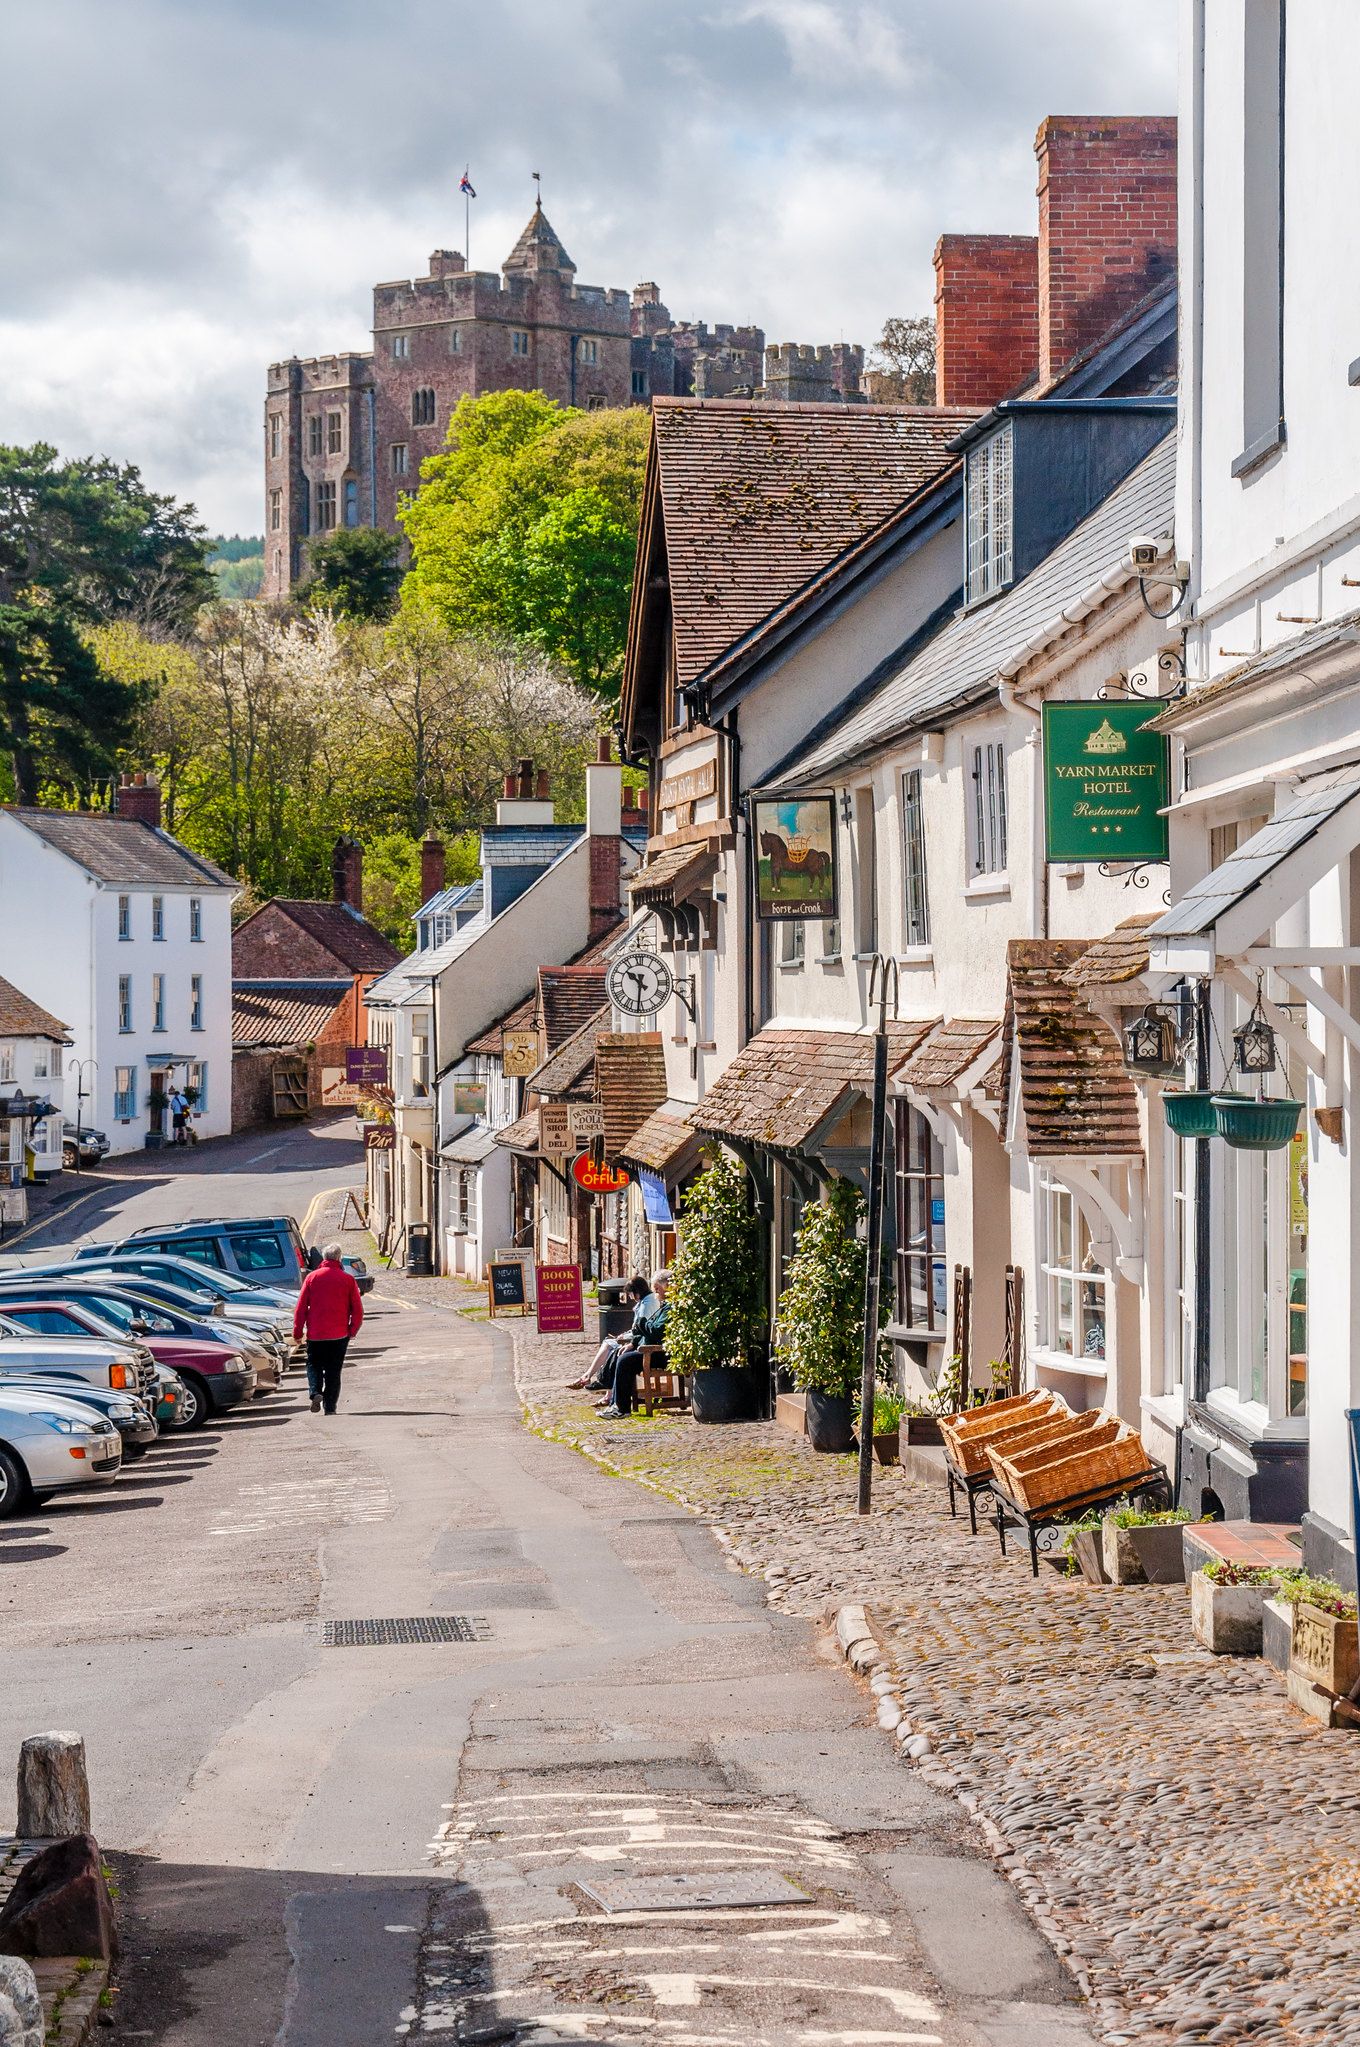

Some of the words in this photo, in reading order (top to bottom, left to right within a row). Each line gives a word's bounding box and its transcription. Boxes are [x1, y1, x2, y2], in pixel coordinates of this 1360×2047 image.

[1056, 766, 1095, 777] YARN
[1098, 765, 1156, 776] MARKET
[1084, 782, 1132, 794] HOTEL
[1073, 801, 1141, 817] Restaurant
[514, 1045, 529, 1061] 5
[572, 1108, 603, 1119] DUNSTE
[367, 1131, 393, 1147] Bar
[583, 1174, 626, 1184] OFFICE
[542, 1271, 576, 1280] BOOK
[544, 1283, 574, 1292] SHOP
